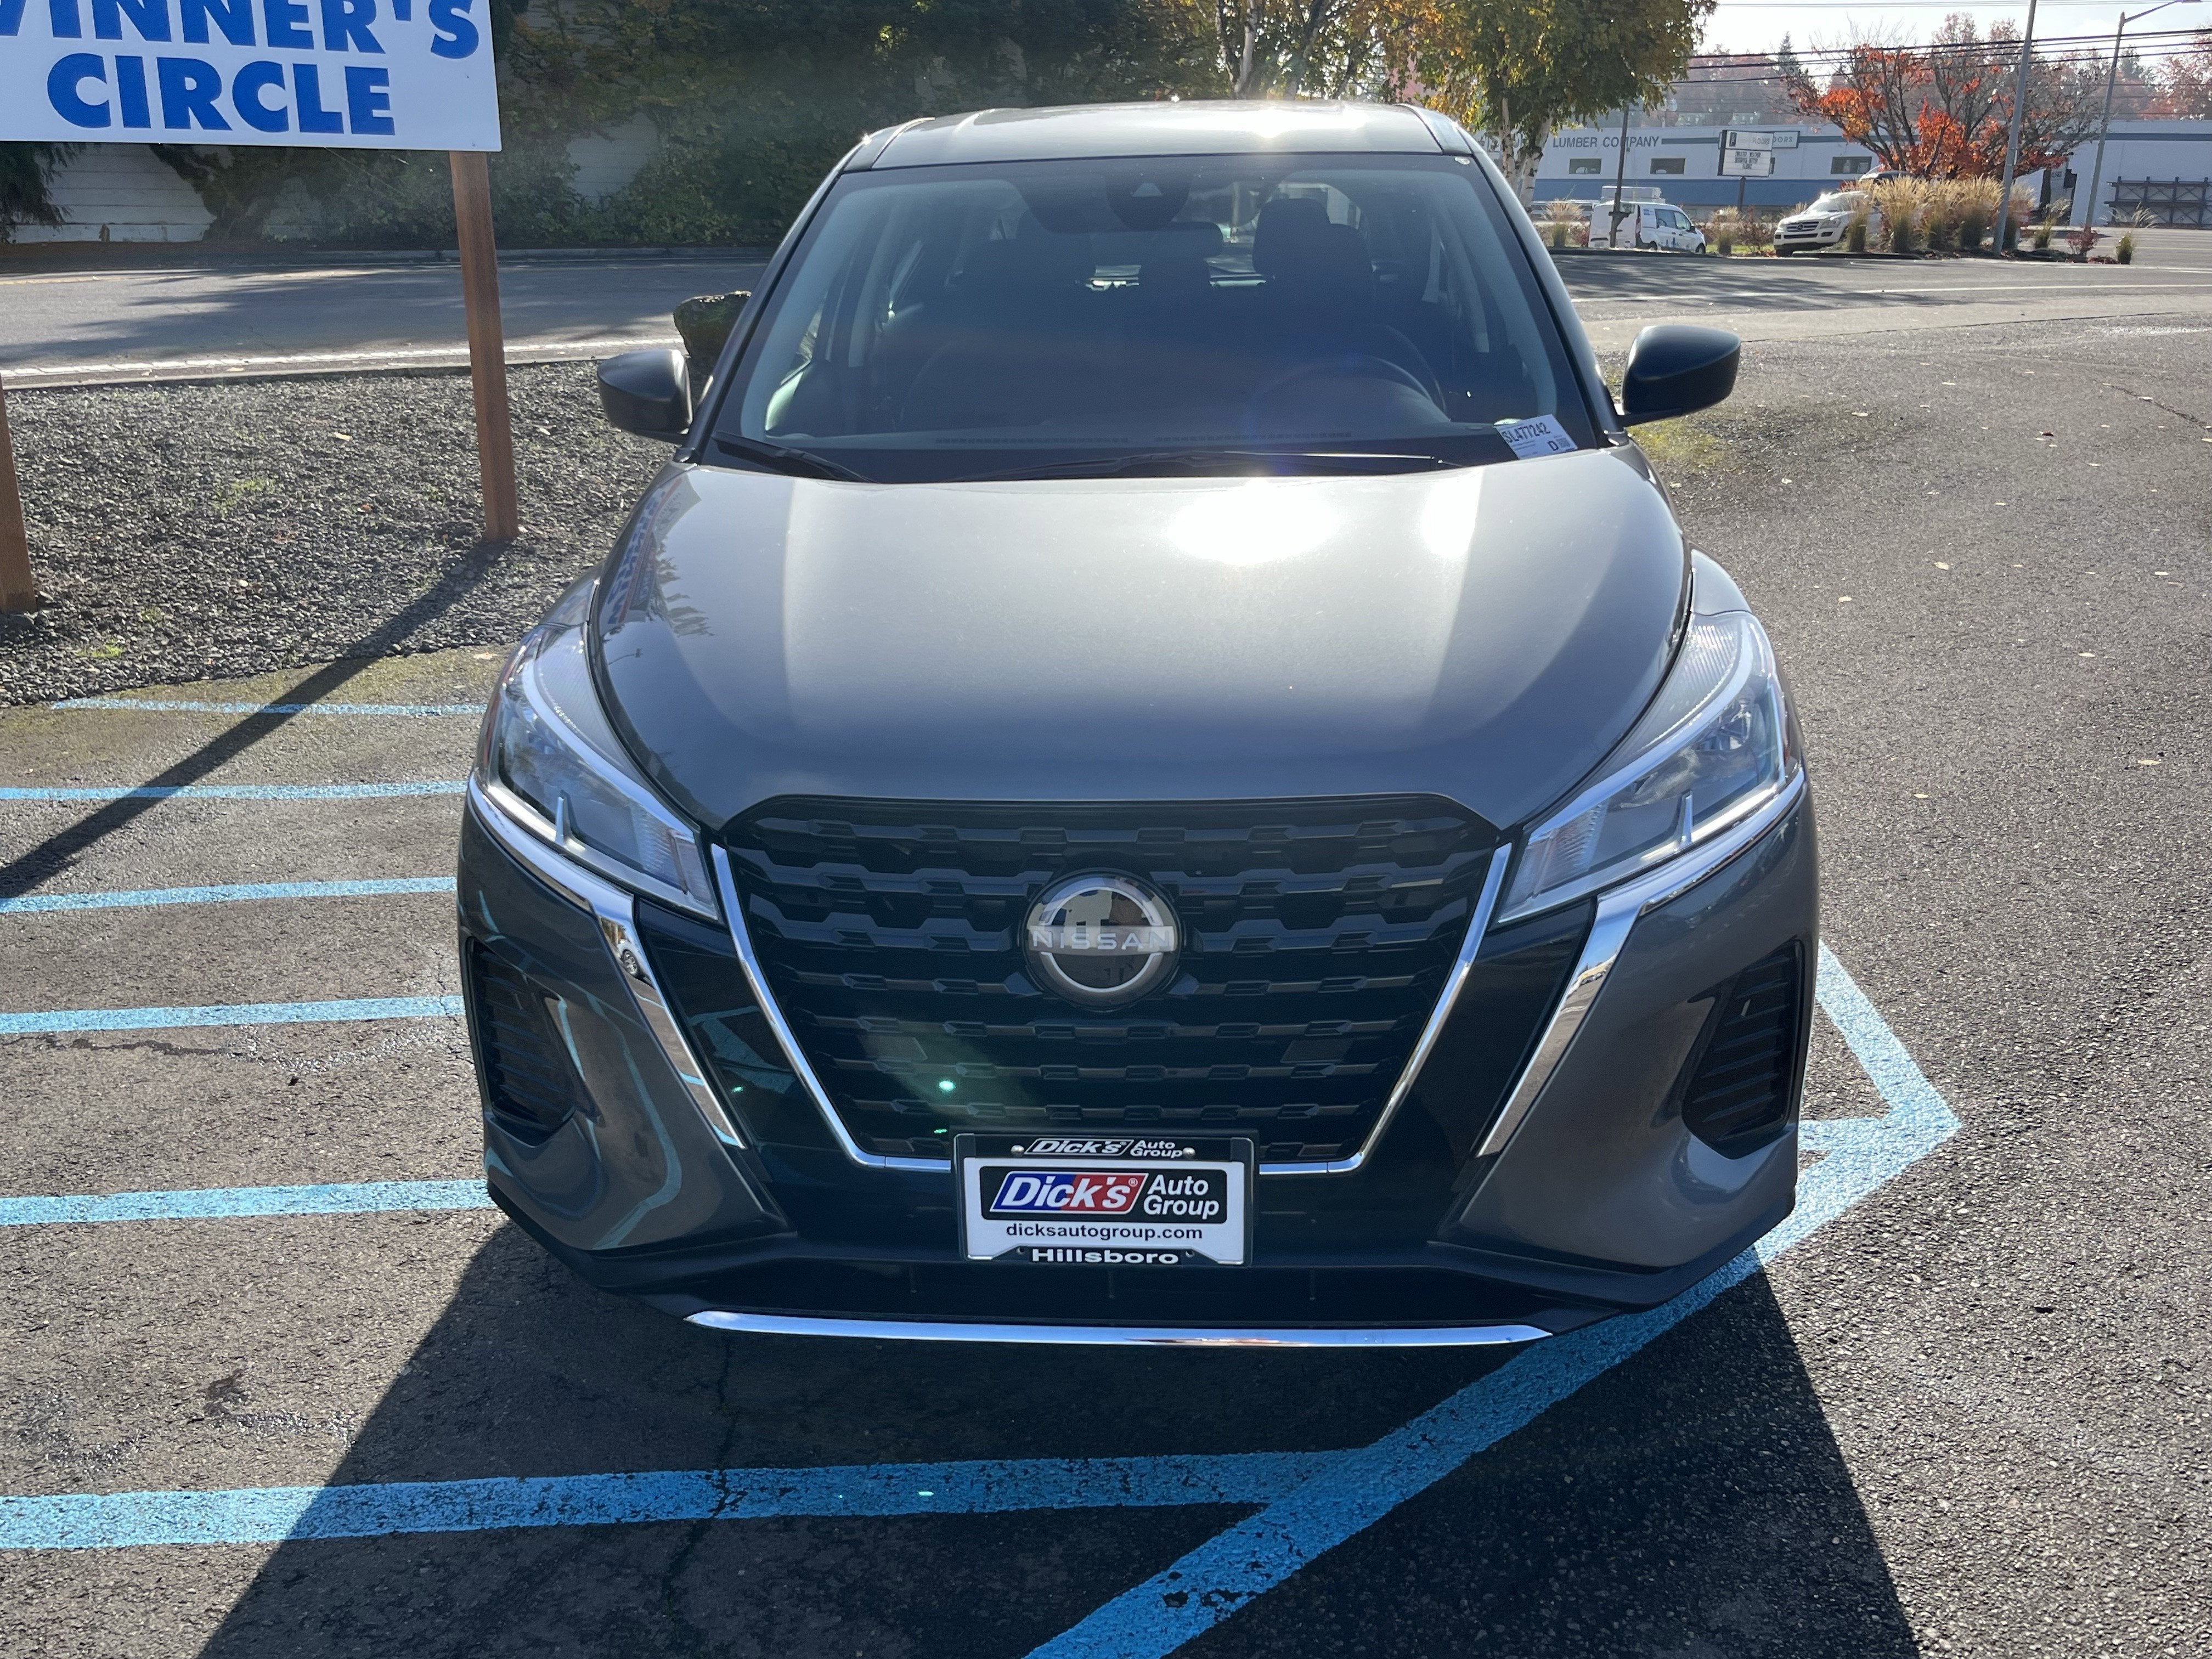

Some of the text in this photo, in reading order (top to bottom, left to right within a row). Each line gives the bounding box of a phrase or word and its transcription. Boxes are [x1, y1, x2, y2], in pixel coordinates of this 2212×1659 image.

[0, 0, 479, 59] INNER'S
[47, 53, 395, 136] CIRCLE
[1553, 137, 1597, 148] LUMBER
[1547, 441, 1559, 452] D
[1032, 930, 1171, 950] NISSAN
[1130, 1147, 1183, 1159] Group
[1133, 1139, 1176, 1149] Auto
[1000, 1175, 1132, 1210] Dick's
[1147, 1174, 1209, 1197] Auto
[1143, 1195, 1220, 1220] Group
[1006, 1223, 1203, 1242] dicksautogroup.com
[1032, 1248, 1179, 1264] Hillsboro
